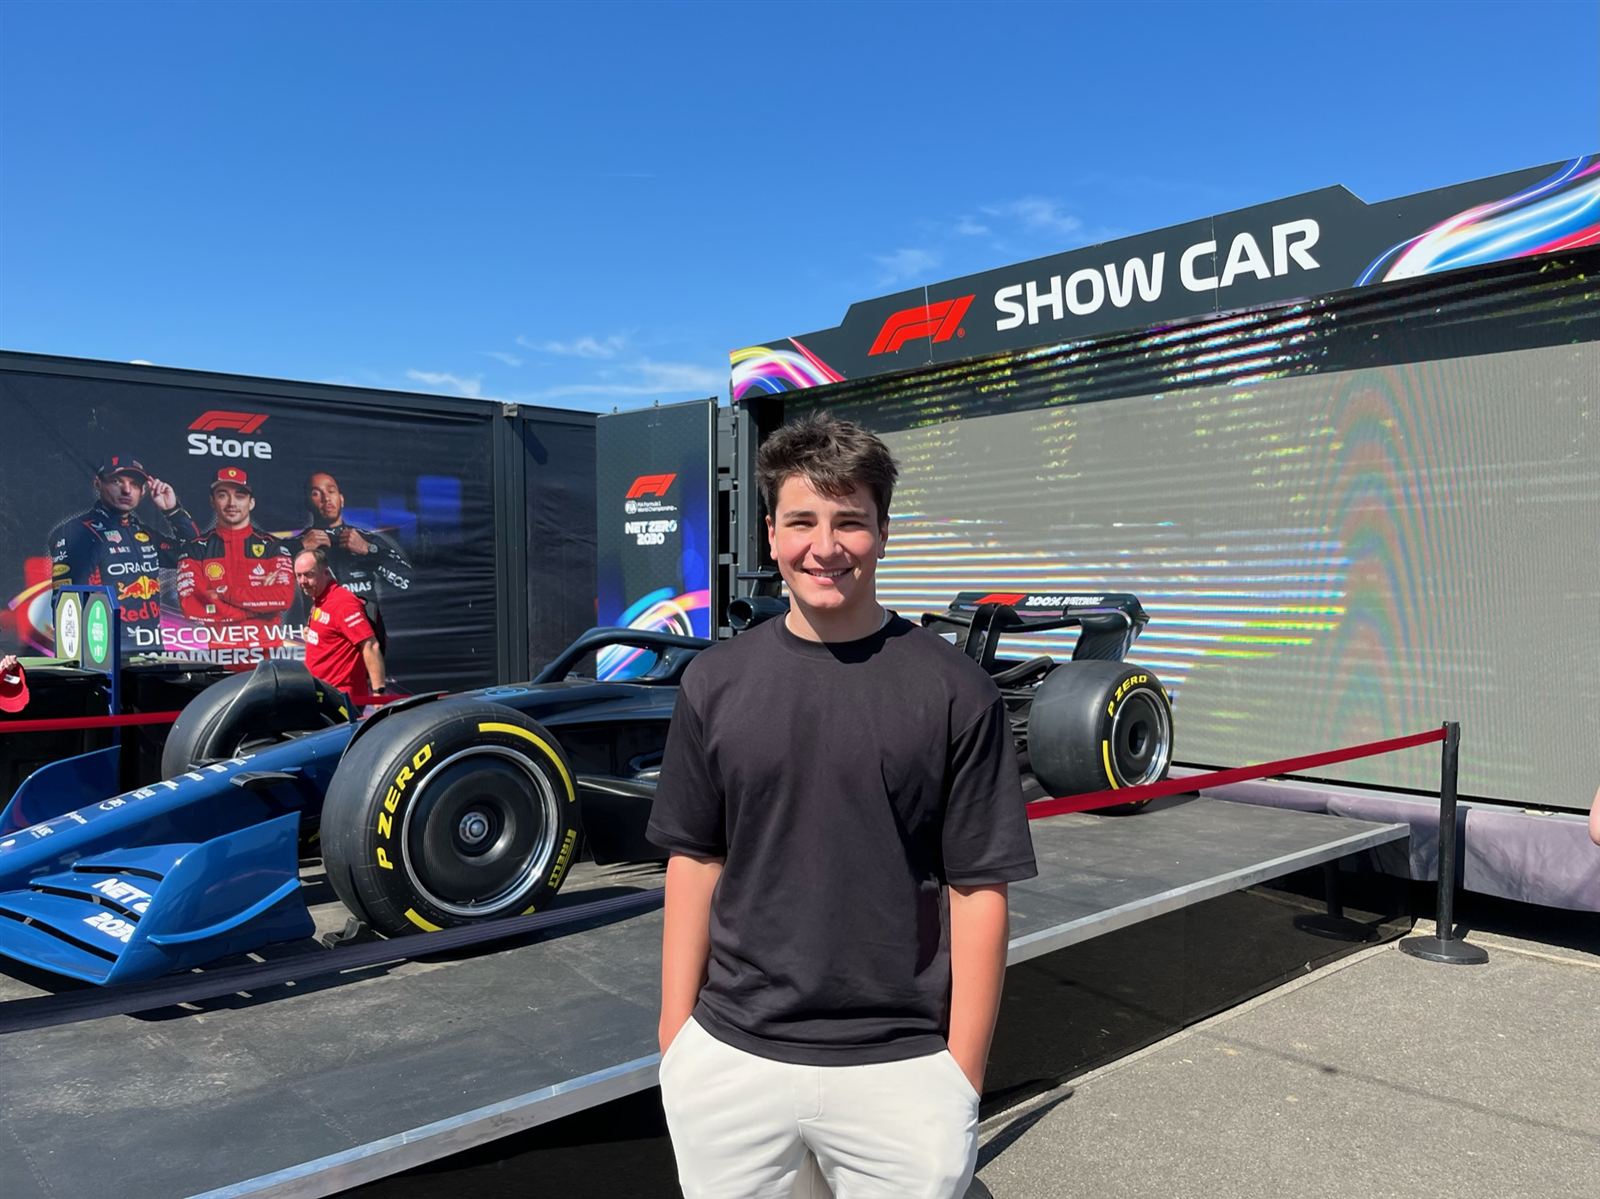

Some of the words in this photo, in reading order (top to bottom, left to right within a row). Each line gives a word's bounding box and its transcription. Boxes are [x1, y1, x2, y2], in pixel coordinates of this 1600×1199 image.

[867, 293, 976, 357] F1
[993, 251, 1165, 332] SHOW
[1179, 218, 1321, 293] CAR
[188, 410, 270, 434] F1
[187, 432, 272, 460] Store
[625, 473, 677, 498] F1
[625, 521, 648, 534] NET
[647, 519, 678, 533] ZERO
[637, 532, 665, 545] 2030
[136, 625, 259, 646] DISCOVER
[1107, 700, 1116, 718] P
[1114, 674, 1148, 702] ZERO
[377, 742, 434, 840] ZERO
[376, 846, 394, 870] P
